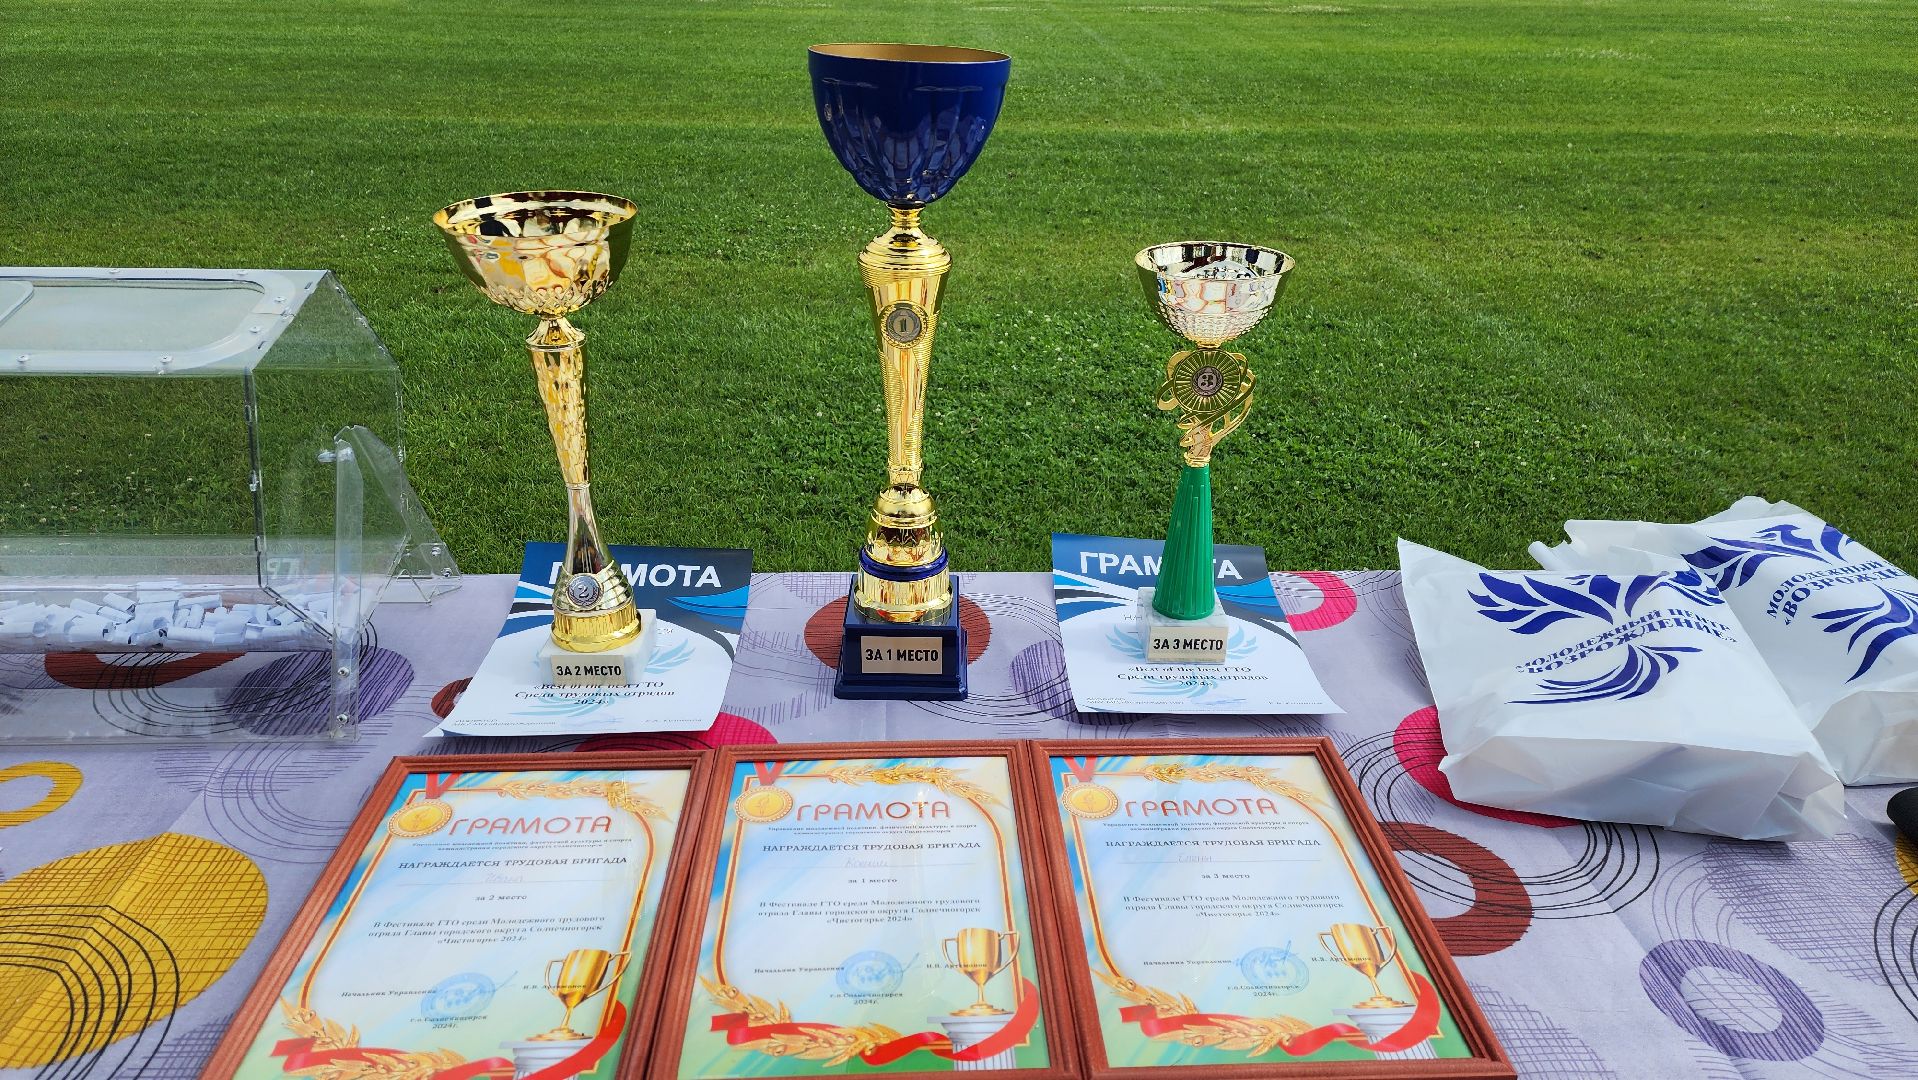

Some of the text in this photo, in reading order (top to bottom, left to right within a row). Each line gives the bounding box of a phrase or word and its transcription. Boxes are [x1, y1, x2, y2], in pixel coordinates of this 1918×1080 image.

[1201, 374, 1214, 387] 3
[1080, 551, 1243, 580] ГРАМА
[549, 561, 722, 588] ГМОТА
[577, 584, 590, 598] 2
[1153, 638, 1224, 650] ЗА 3 МЕСТО
[865, 648, 939, 661] ЗА 1 МЕСТО
[556, 665, 622, 676] ЗА 2 МЕСТО
[795, 800, 951, 821] ГРАМОТА
[1124, 797, 1280, 817] ГРАМОТА
[448, 815, 613, 836] ГРАМОТА
[762, 844, 859, 852] НАГРАЖДАЕТСЯ
[862, 843, 924, 851] ТРУДОВАЯ
[398, 857, 627, 869] НАГРАЖДАЕТСЯ ТРУДОВАЯ БРИГАДА
